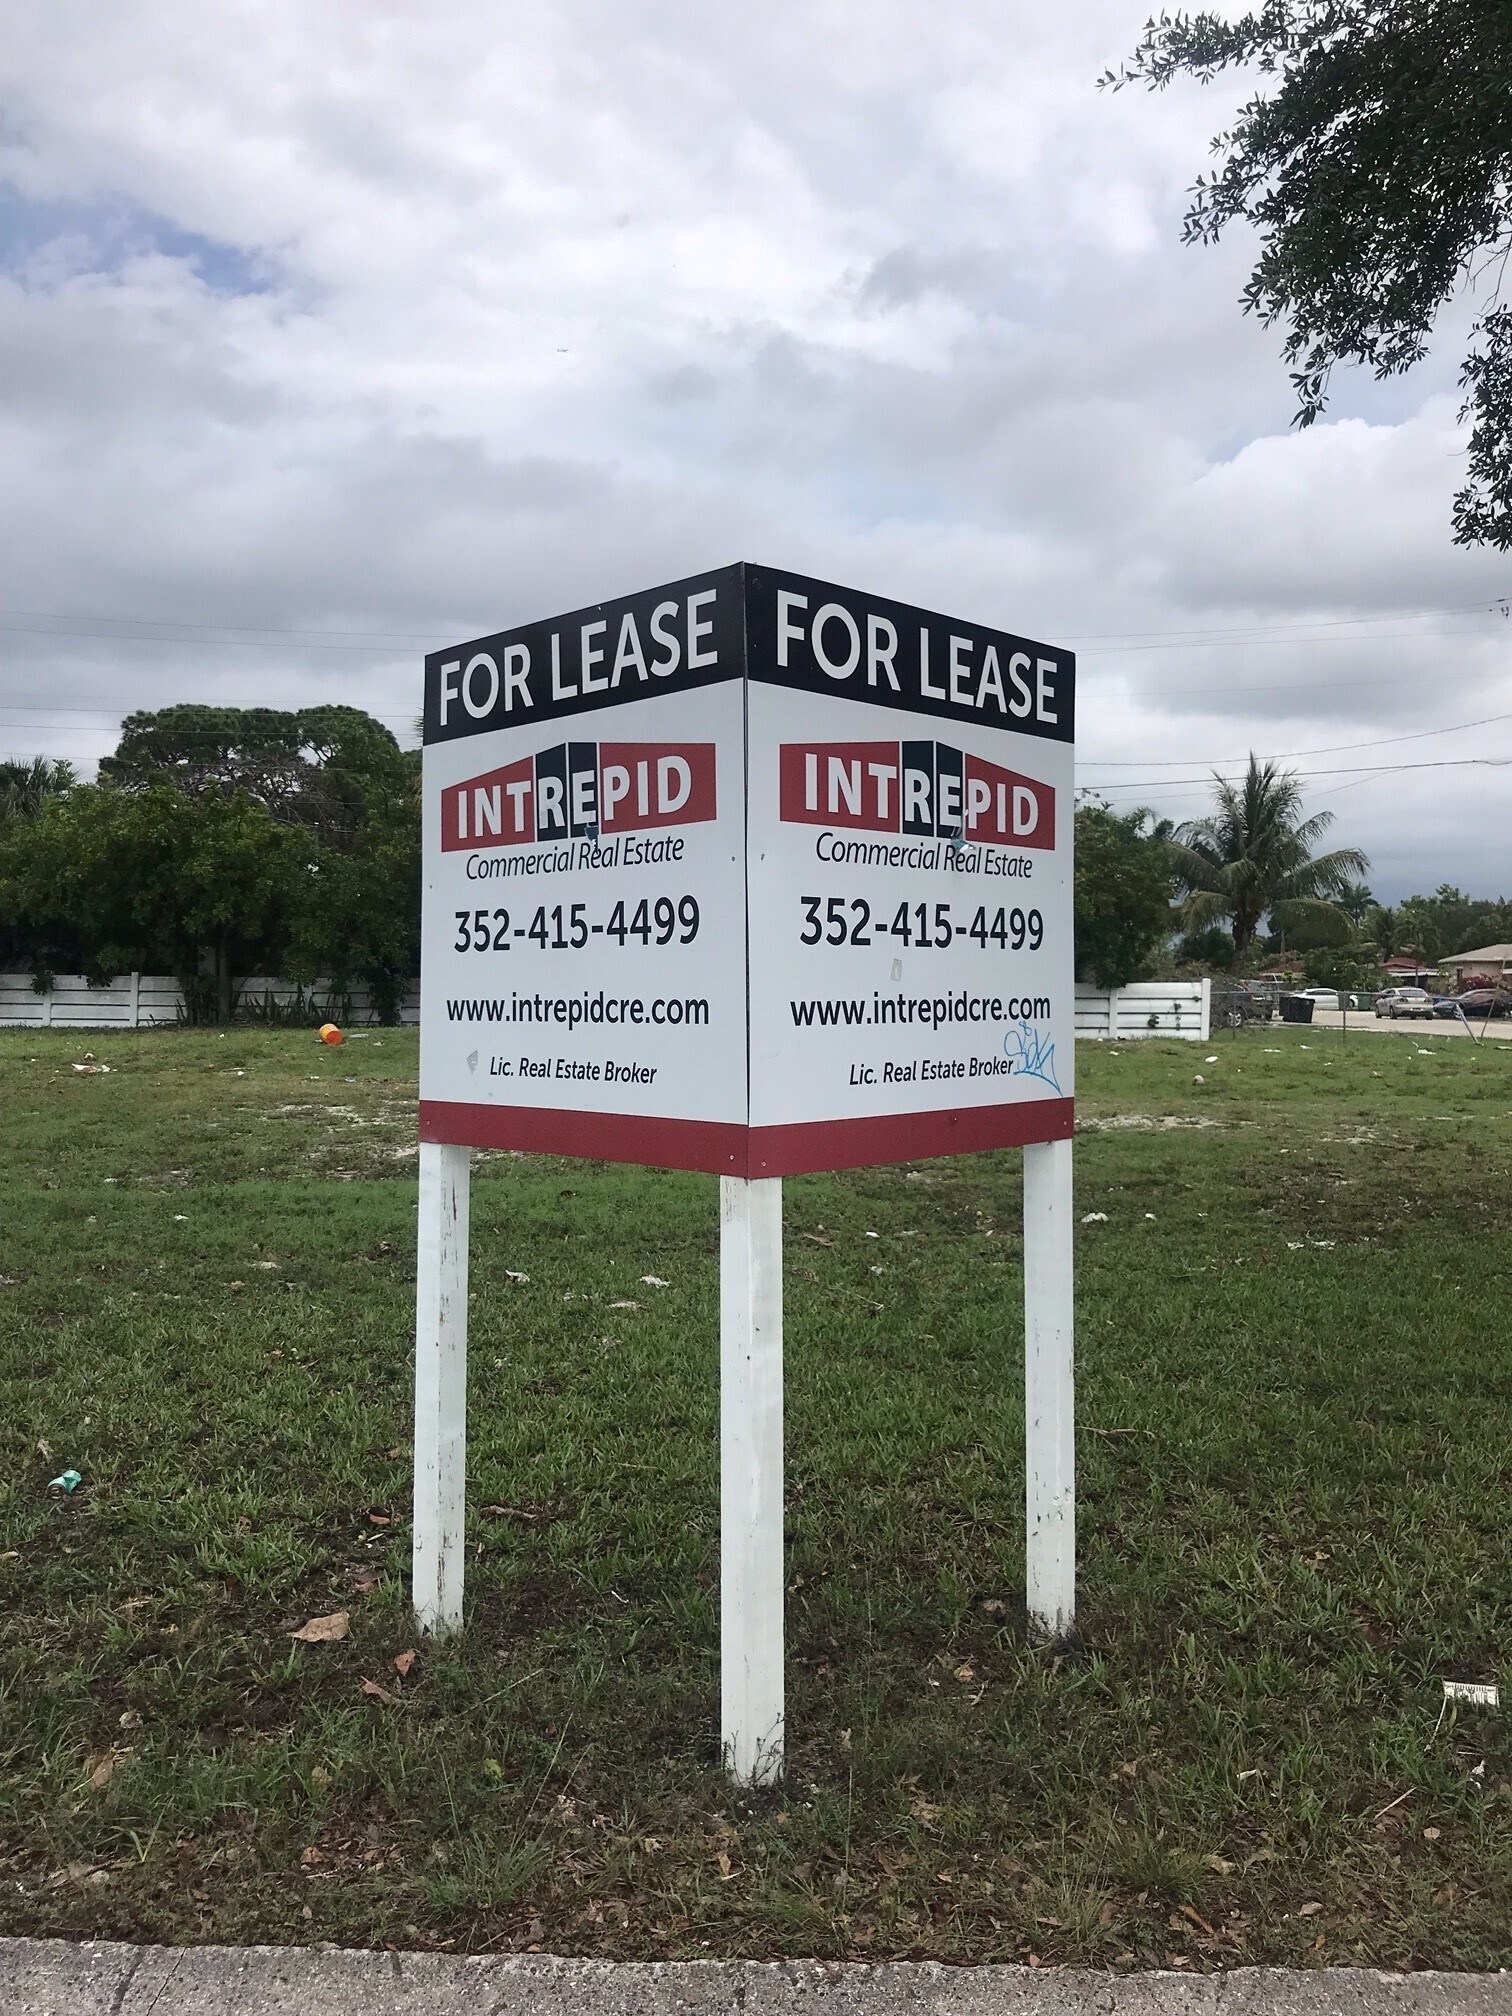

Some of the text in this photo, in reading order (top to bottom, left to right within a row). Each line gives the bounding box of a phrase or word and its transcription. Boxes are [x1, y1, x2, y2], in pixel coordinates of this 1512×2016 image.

[440, 589, 718, 726] FOR LEASE
[777, 589, 1058, 724] FOR LEASE
[458, 755, 692, 839] INTREPID
[805, 753, 1039, 836] INTREPID
[466, 836, 685, 880] Commercial Real Estate
[816, 832, 1033, 878] Commercial Real Estate
[454, 894, 700, 952] 352-415-4499
[799, 896, 1043, 951] 352-415-4499
[447, 991, 709, 1031] www.intrepidcre.com
[790, 991, 1050, 1031] www.intrepidcre.com
[490, 1056, 657, 1084] Lic. Real Estate Broker
[850, 1056, 1014, 1085] Lic. Real Estate Broker
